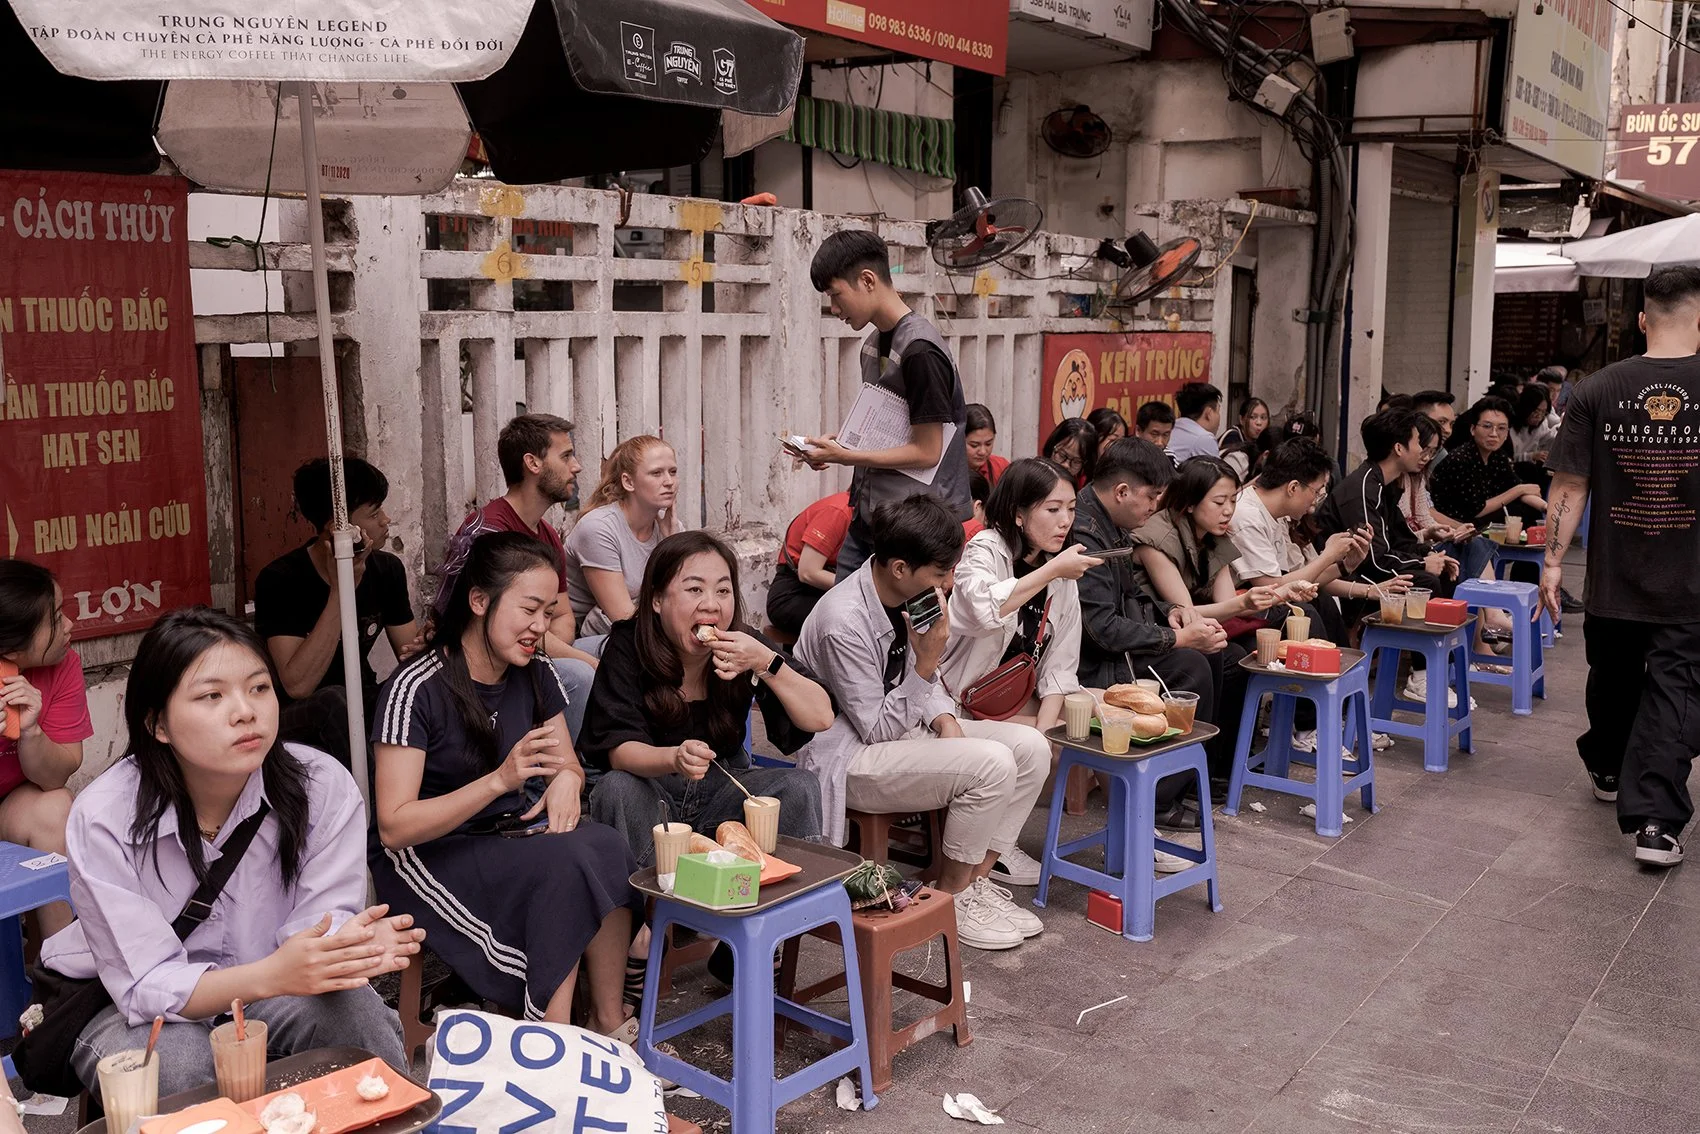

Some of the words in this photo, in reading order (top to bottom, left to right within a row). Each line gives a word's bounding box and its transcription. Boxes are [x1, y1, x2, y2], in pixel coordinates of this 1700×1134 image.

[158, 15, 225, 28] TRUNG
[233, 14, 309, 31] NGUYÊN
[317, 19, 388, 33] LEGEND
[827, 4, 864, 27] Hotline
[868, 12, 887, 32] 098
[888, 17, 906, 37] 983
[907, 22, 931, 44] 6336
[937, 31, 954, 50] 090
[956, 36, 971, 53] 414
[971, 40, 993, 60] 8330
[30, 26, 59, 40] TẬP
[67, 27, 117, 42] ĐOÀN
[123, 30, 191, 44] CHUYÊN
[196, 31, 217, 44] CÀ
[223, 31, 253, 45] PHÊ
[259, 33, 304, 46] NĂNG
[310, 36, 364, 50] LƯỢNG
[380, 36, 401, 48] CÀ
[406, 37, 436, 50] PHÊ
[442, 37, 470, 51] ĐỔI
[476, 38, 504, 52] ĐỜI
[673, 45, 693, 57] TRUNG
[141, 48, 168, 59] THE
[173, 49, 224, 60] ENERGY
[229, 50, 276, 60] COFFEE
[283, 51, 313, 62] THAT
[319, 53, 379, 63] CHANGES
[384, 53, 409, 64] LIFE
[666, 56, 699, 75] NGUYÊN
[717, 59, 735, 77] G7
[1625, 111, 1655, 134] BÚN
[1661, 107, 1678, 132] ỐC
[1646, 136, 1698, 166] 57
[13, 186, 96, 242] CÁCH
[100, 188, 175, 244] THỦY
[497, 251, 512, 274] 6
[691, 261, 701, 281] 5
[21, 285, 115, 333] THUỐC
[122, 286, 169, 332] BẮC
[1100, 349, 1141, 385] KEM
[1146, 340, 1205, 382] TRỨNG
[0, 372, 39, 421] ẦN
[44, 369, 128, 419] THUỐC
[134, 367, 175, 413] BẮC
[1637, 383, 1663, 400] MICHAEL
[1664, 383, 1690, 401] JACKSON
[1618, 400, 1649, 411] KING
[42, 431, 90, 474] HẠT
[97, 428, 141, 464] SEN
[1603, 434, 1639, 443] WORLD
[1641, 436, 1669, 444] TOUR
[34, 514, 78, 555] RAU
[86, 501, 142, 546] NGẢI
[149, 498, 191, 539] CỨU
[73, 578, 163, 624] LỢN
[498, 1025, 566, 1134] VO
